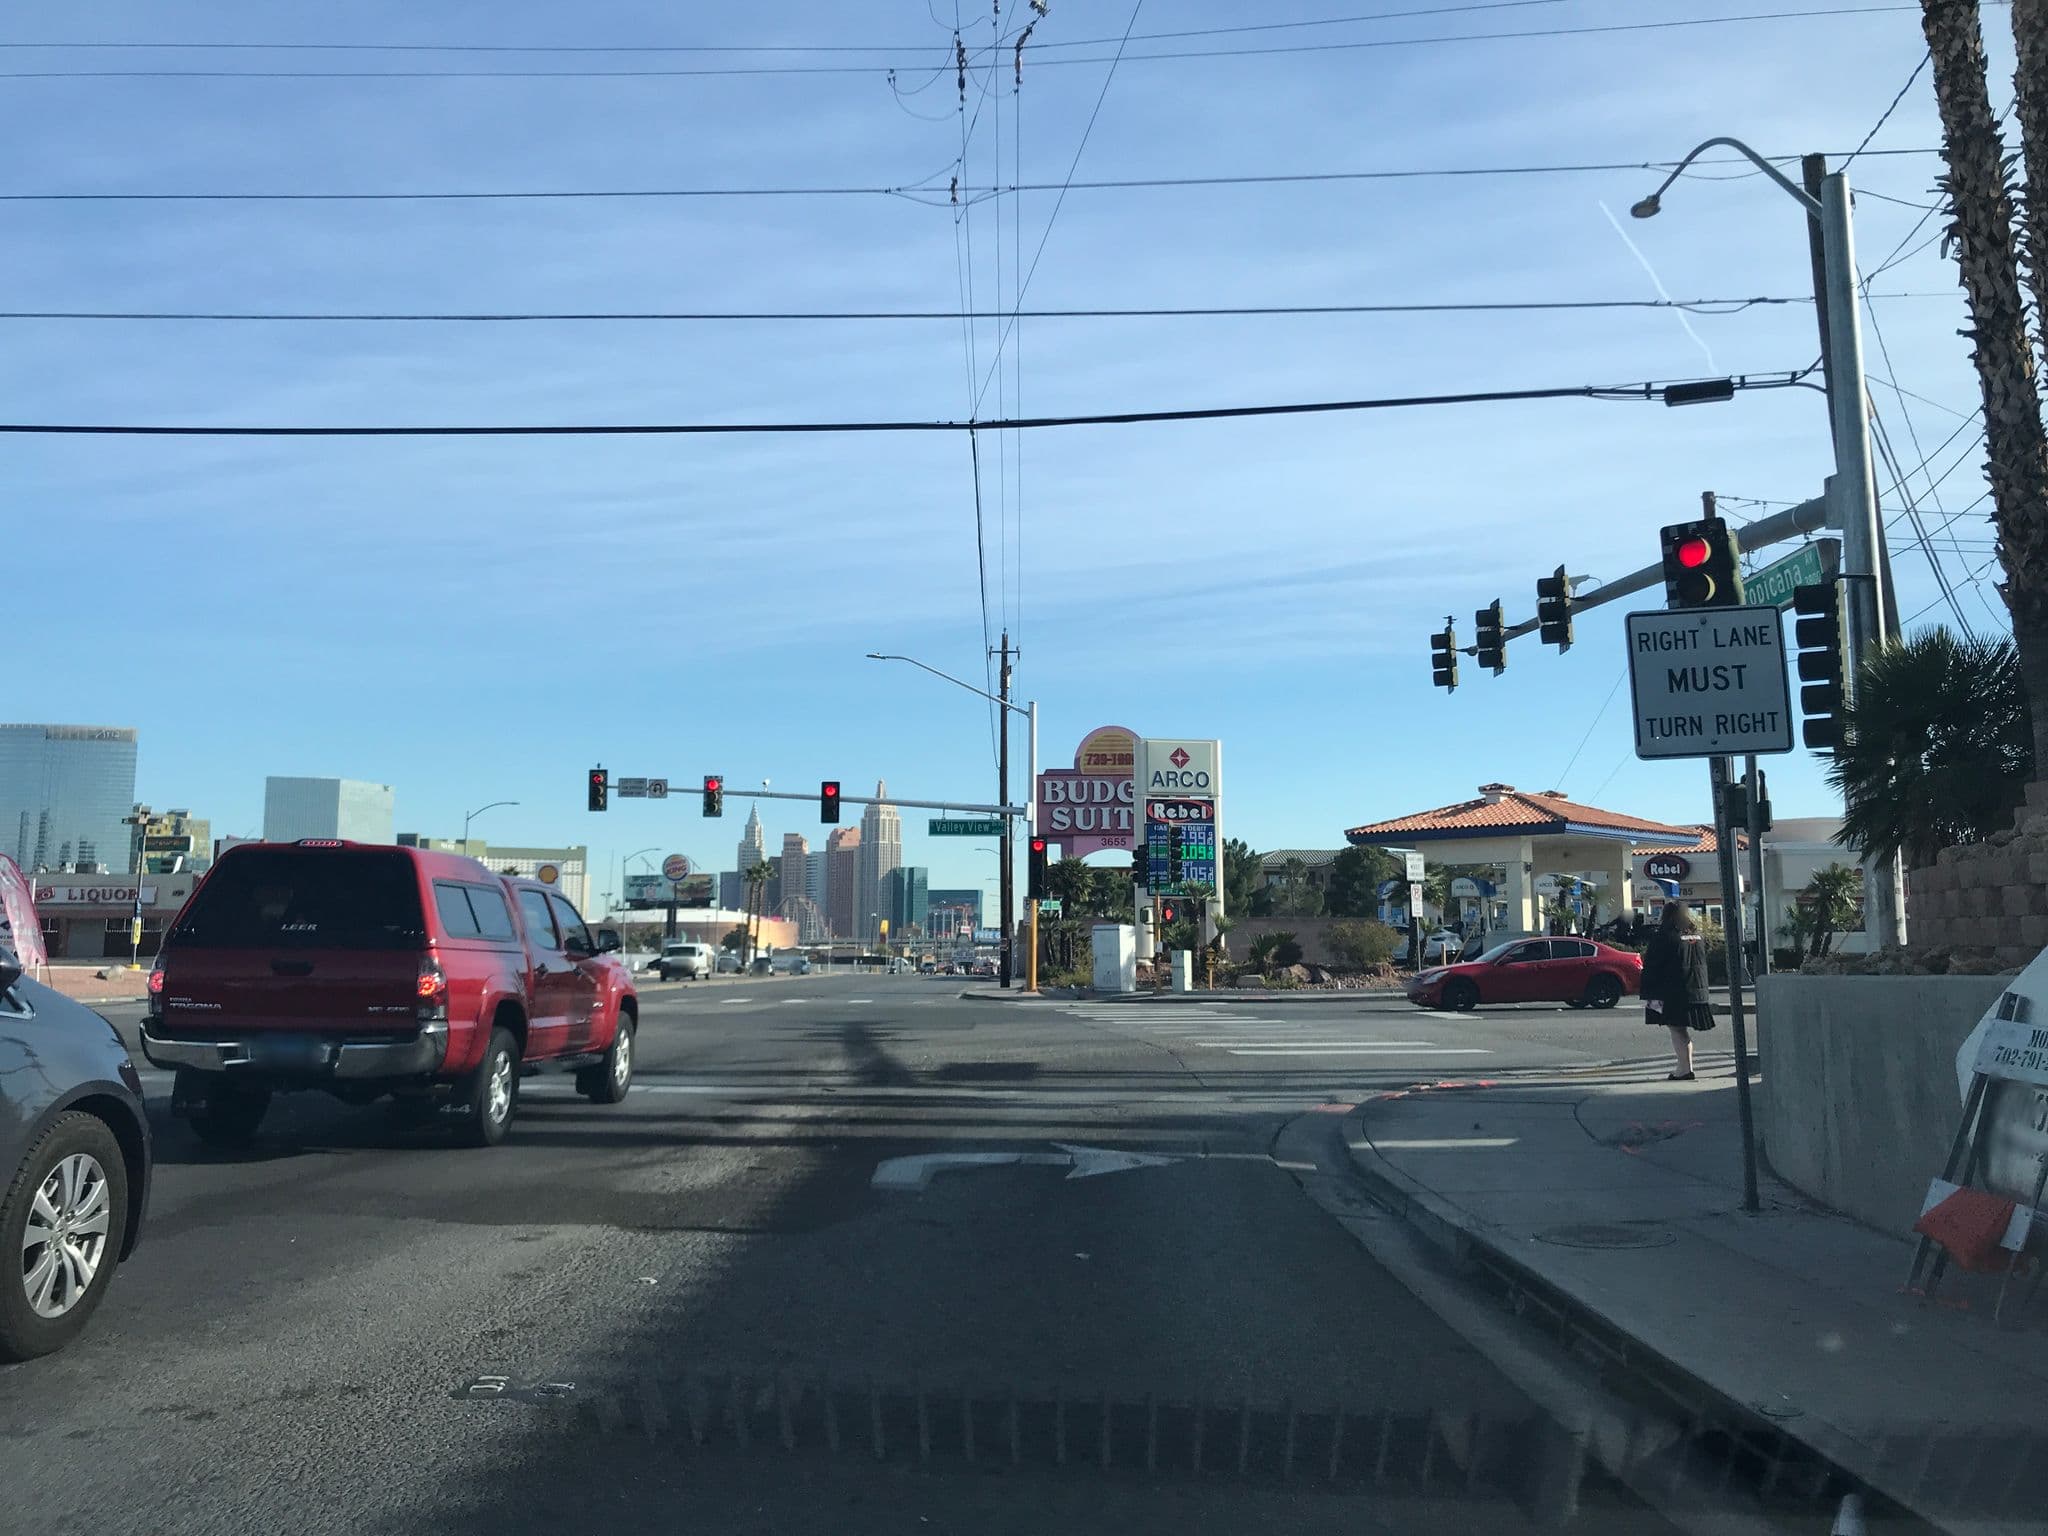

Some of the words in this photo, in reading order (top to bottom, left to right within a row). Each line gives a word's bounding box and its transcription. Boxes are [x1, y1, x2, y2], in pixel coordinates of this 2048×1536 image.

[1637, 629, 1699, 652] RIGHT
[1713, 625, 1772, 648] LANE
[1668, 664, 1747, 693] MUST
[1646, 715, 1703, 738] TURN
[1715, 711, 1779, 735] RIGHT
[1151, 770, 1210, 788] ARCO
[1043, 779, 1134, 804] BUDG
[1050, 806, 1134, 831] SUIT
[1153, 802, 1208, 820] Rebel
[935, 820, 964, 833] Valley
[967, 820, 990, 832] View
[1101, 838, 1127, 846] 3655
[1650, 863, 1681, 875] Rebel
[68, 888, 138, 902] LIQUOR
[281, 923, 318, 931] LEER
[2028, 1029, 2048, 1048] MO
